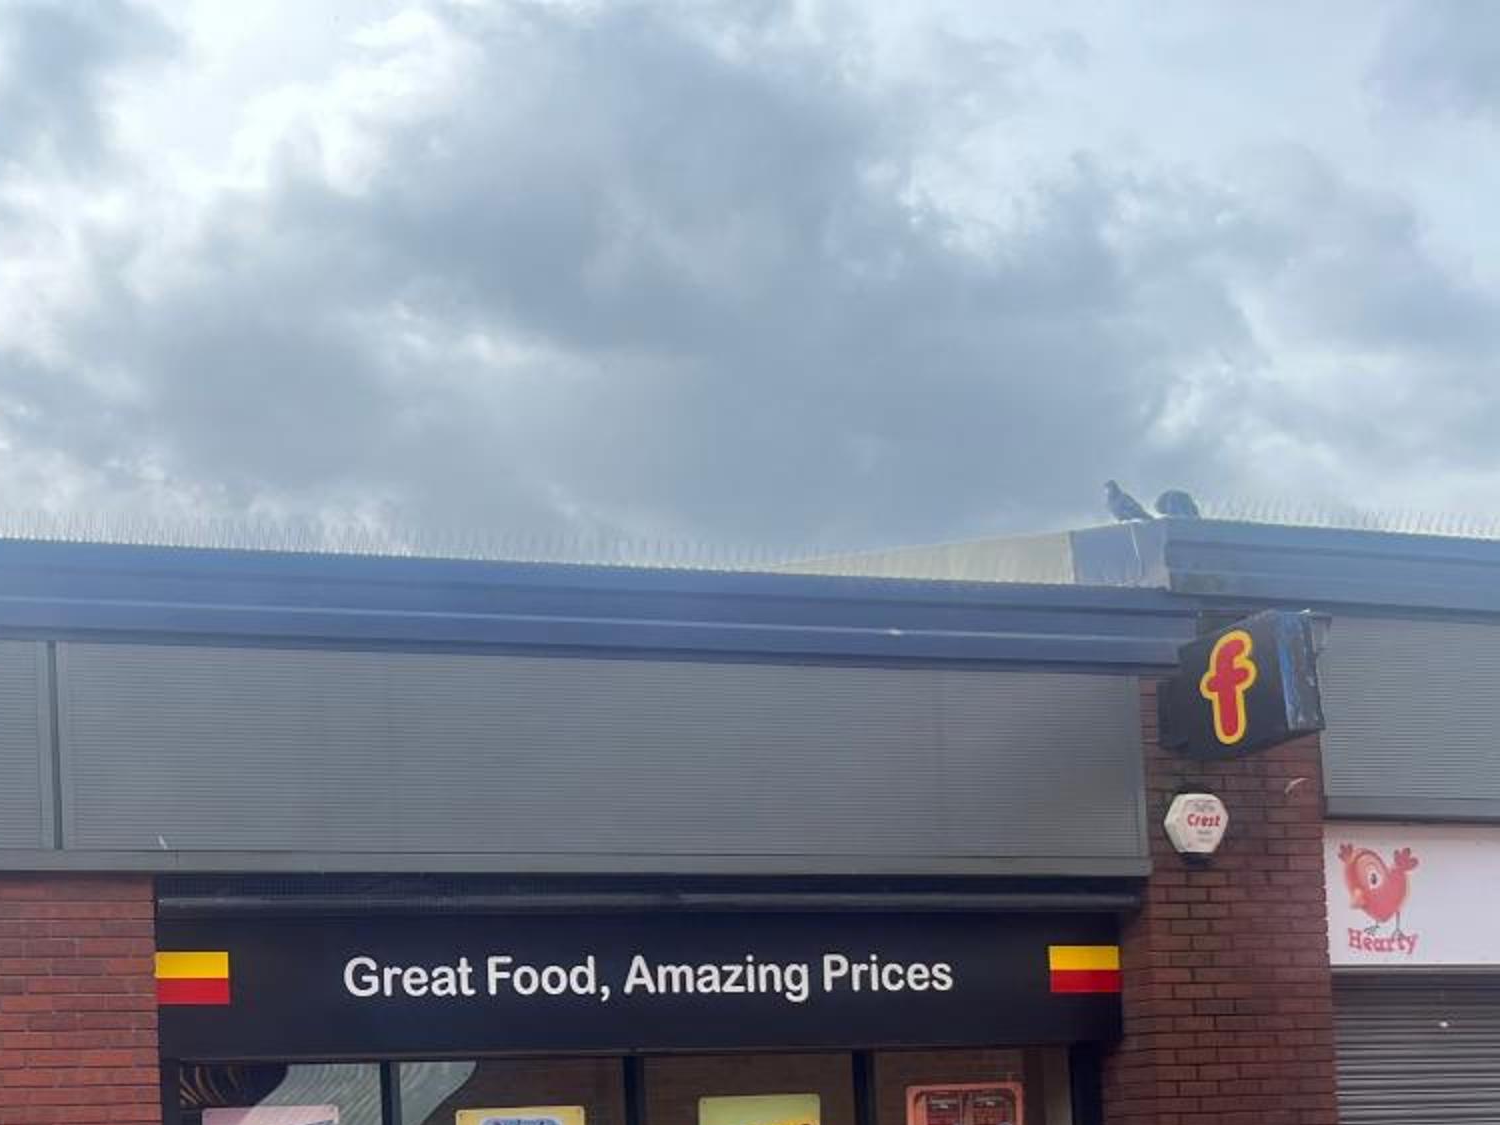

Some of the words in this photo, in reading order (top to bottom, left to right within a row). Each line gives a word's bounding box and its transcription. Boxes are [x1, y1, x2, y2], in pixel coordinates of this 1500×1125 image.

[1200, 629, 1258, 744] f
[1187, 813, 1221, 827] Crest
[1348, 928, 1418, 954] Hearty
[343, 956, 474, 998] Great
[488, 955, 611, 1002] Food,
[623, 954, 809, 1002] Amazing
[823, 952, 953, 993] Prices
